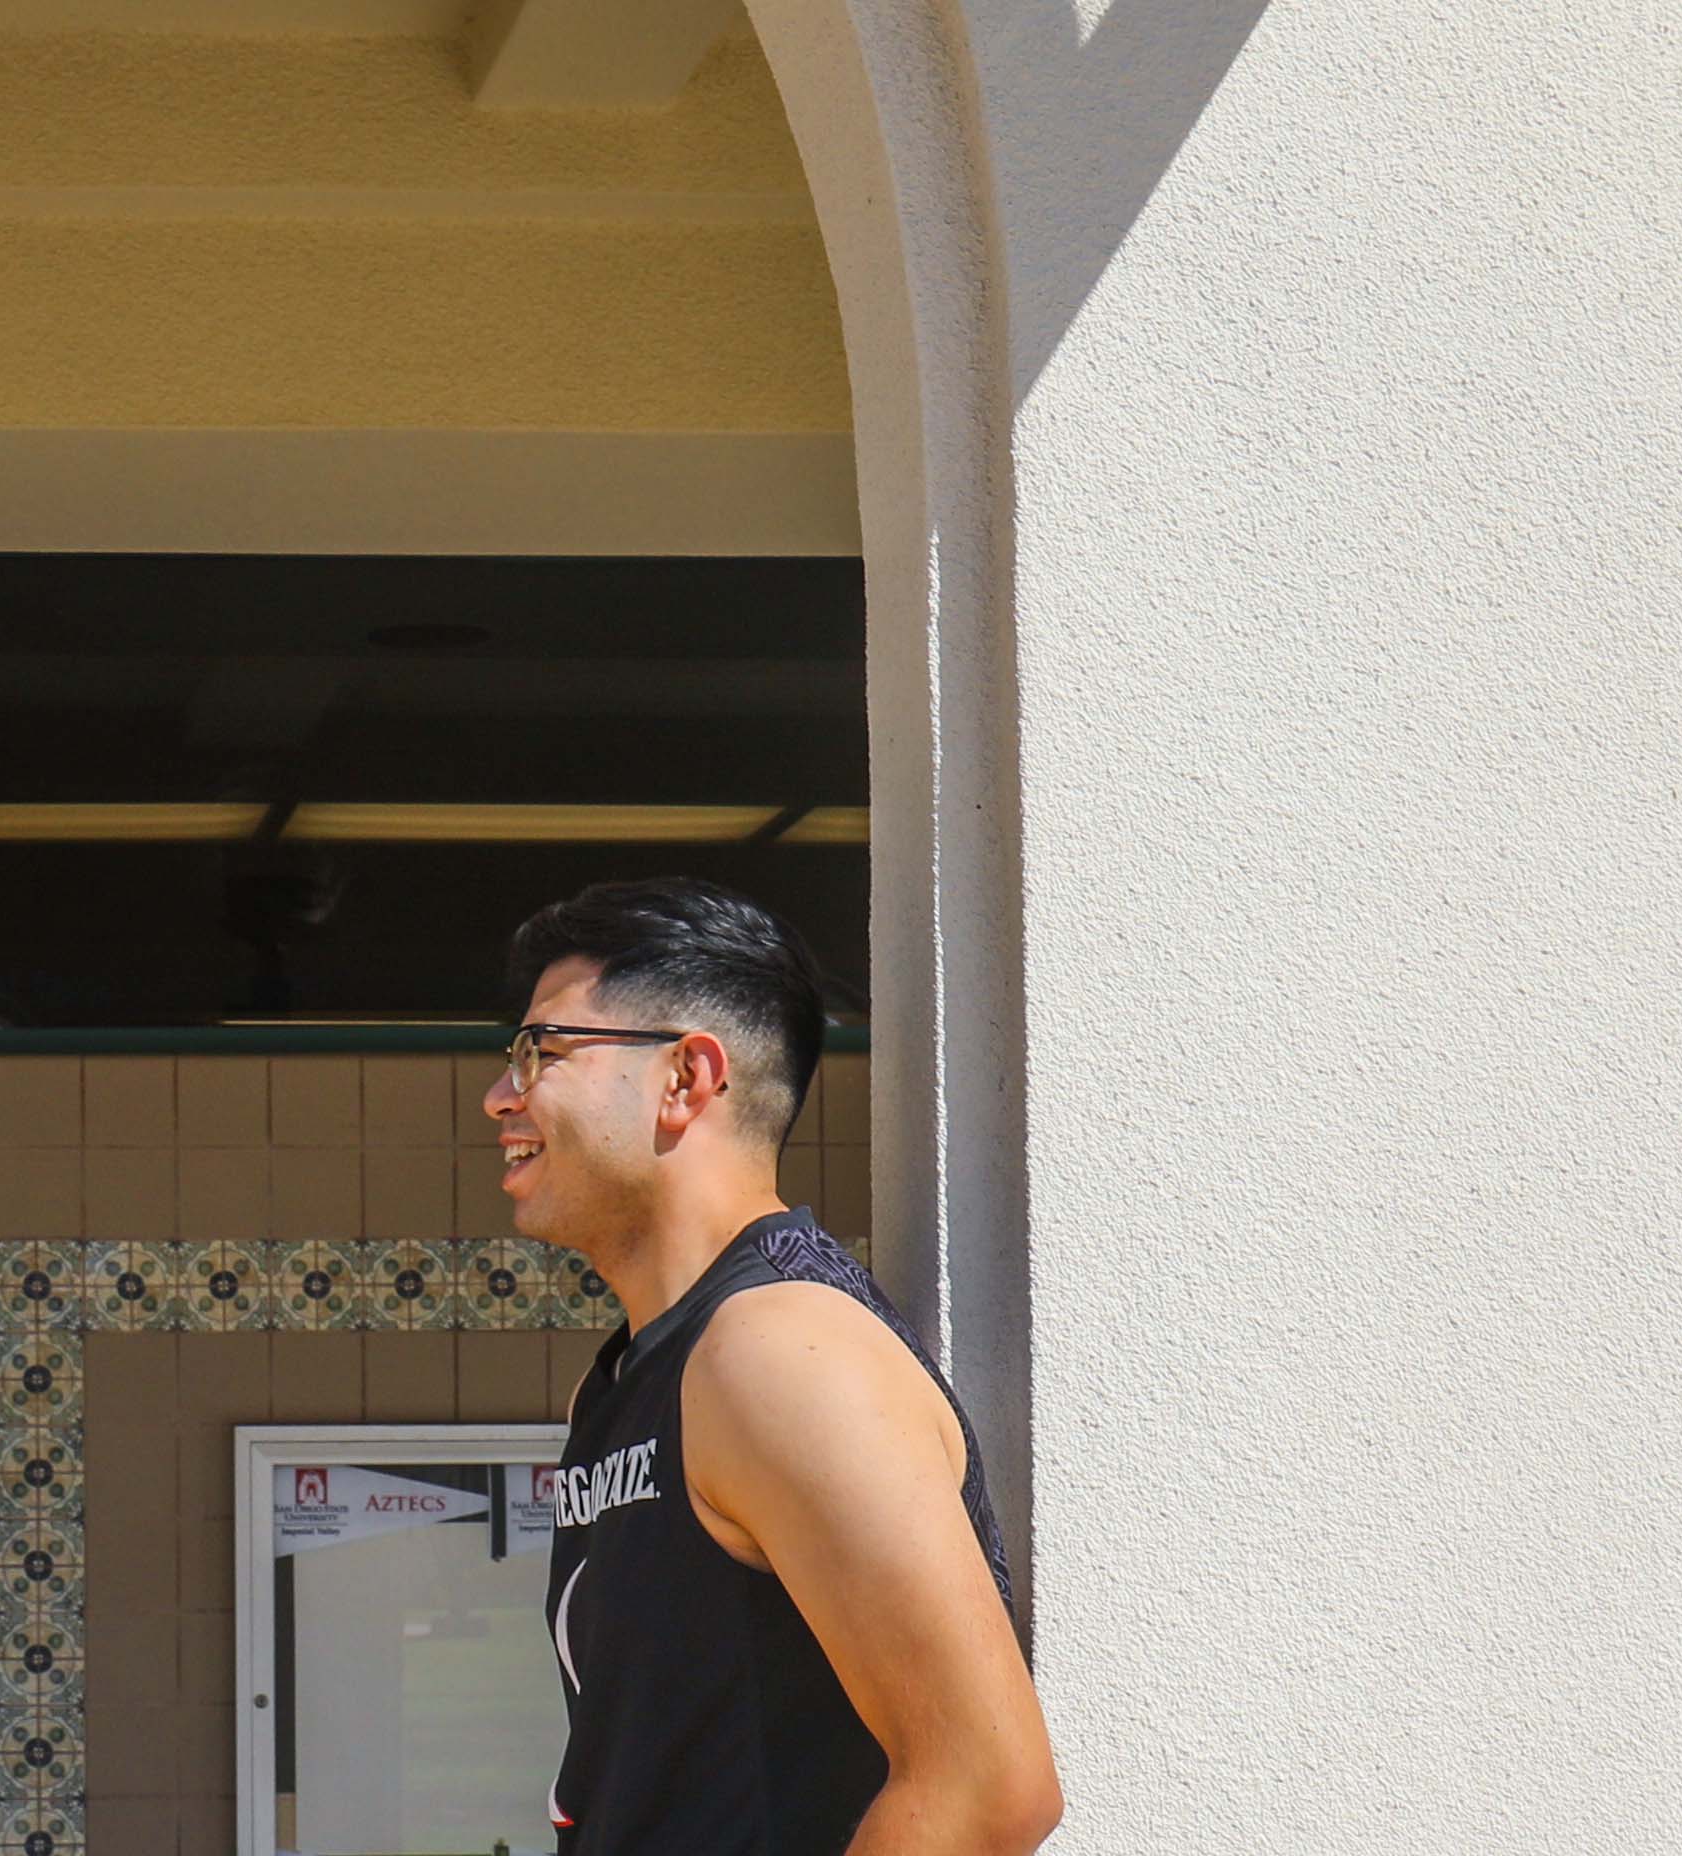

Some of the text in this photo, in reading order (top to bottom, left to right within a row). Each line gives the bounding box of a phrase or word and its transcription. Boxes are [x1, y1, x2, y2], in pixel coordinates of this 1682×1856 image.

[365, 1495, 447, 1512] AZTECS
[284, 1513, 338, 1521] UNIVERSITY
[281, 1527, 341, 1537] Imperial Valley
